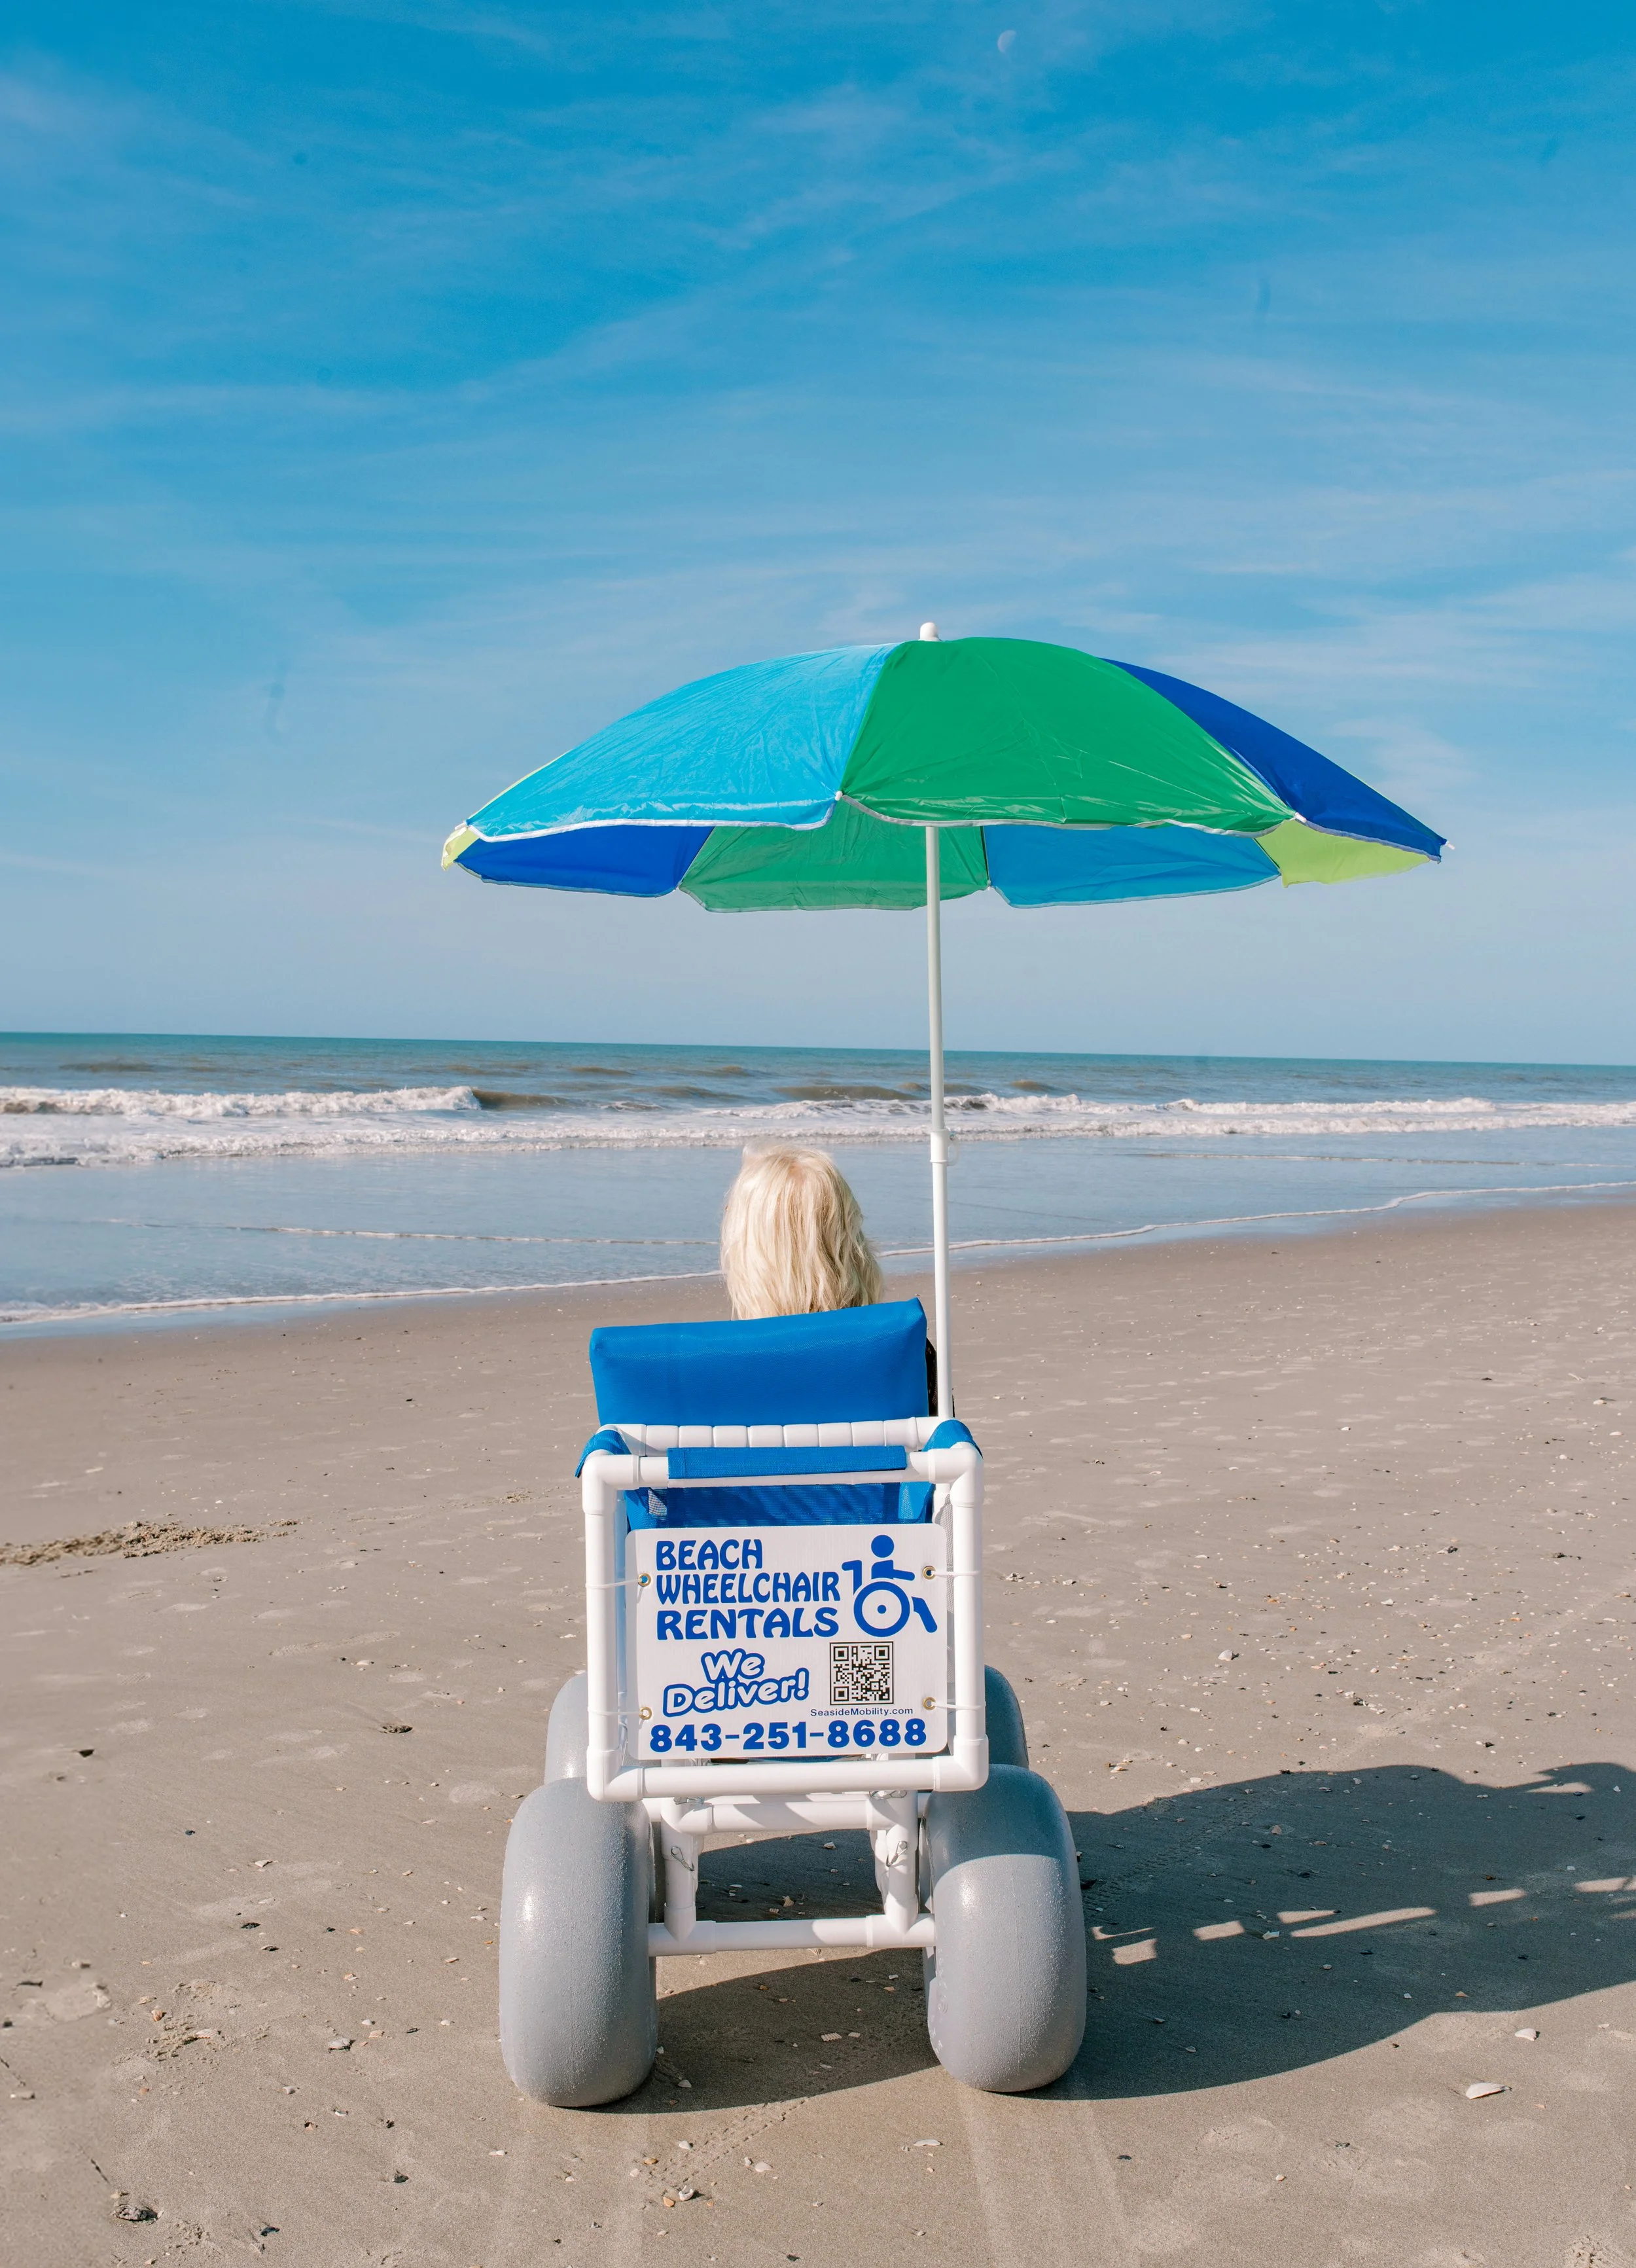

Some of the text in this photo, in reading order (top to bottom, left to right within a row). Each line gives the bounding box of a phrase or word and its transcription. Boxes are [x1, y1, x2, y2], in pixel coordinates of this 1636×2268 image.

[656, 1539, 762, 1570] BEACH
[656, 1572, 840, 1604] WHEELCHAIR
[657, 1607, 839, 1640] RENTALS
[702, 1649, 765, 1680] We
[663, 1668, 809, 1717] Deliver!
[810, 1707, 914, 1717] SeasideMobility.com
[650, 1718, 927, 1752] 843-251-8688
